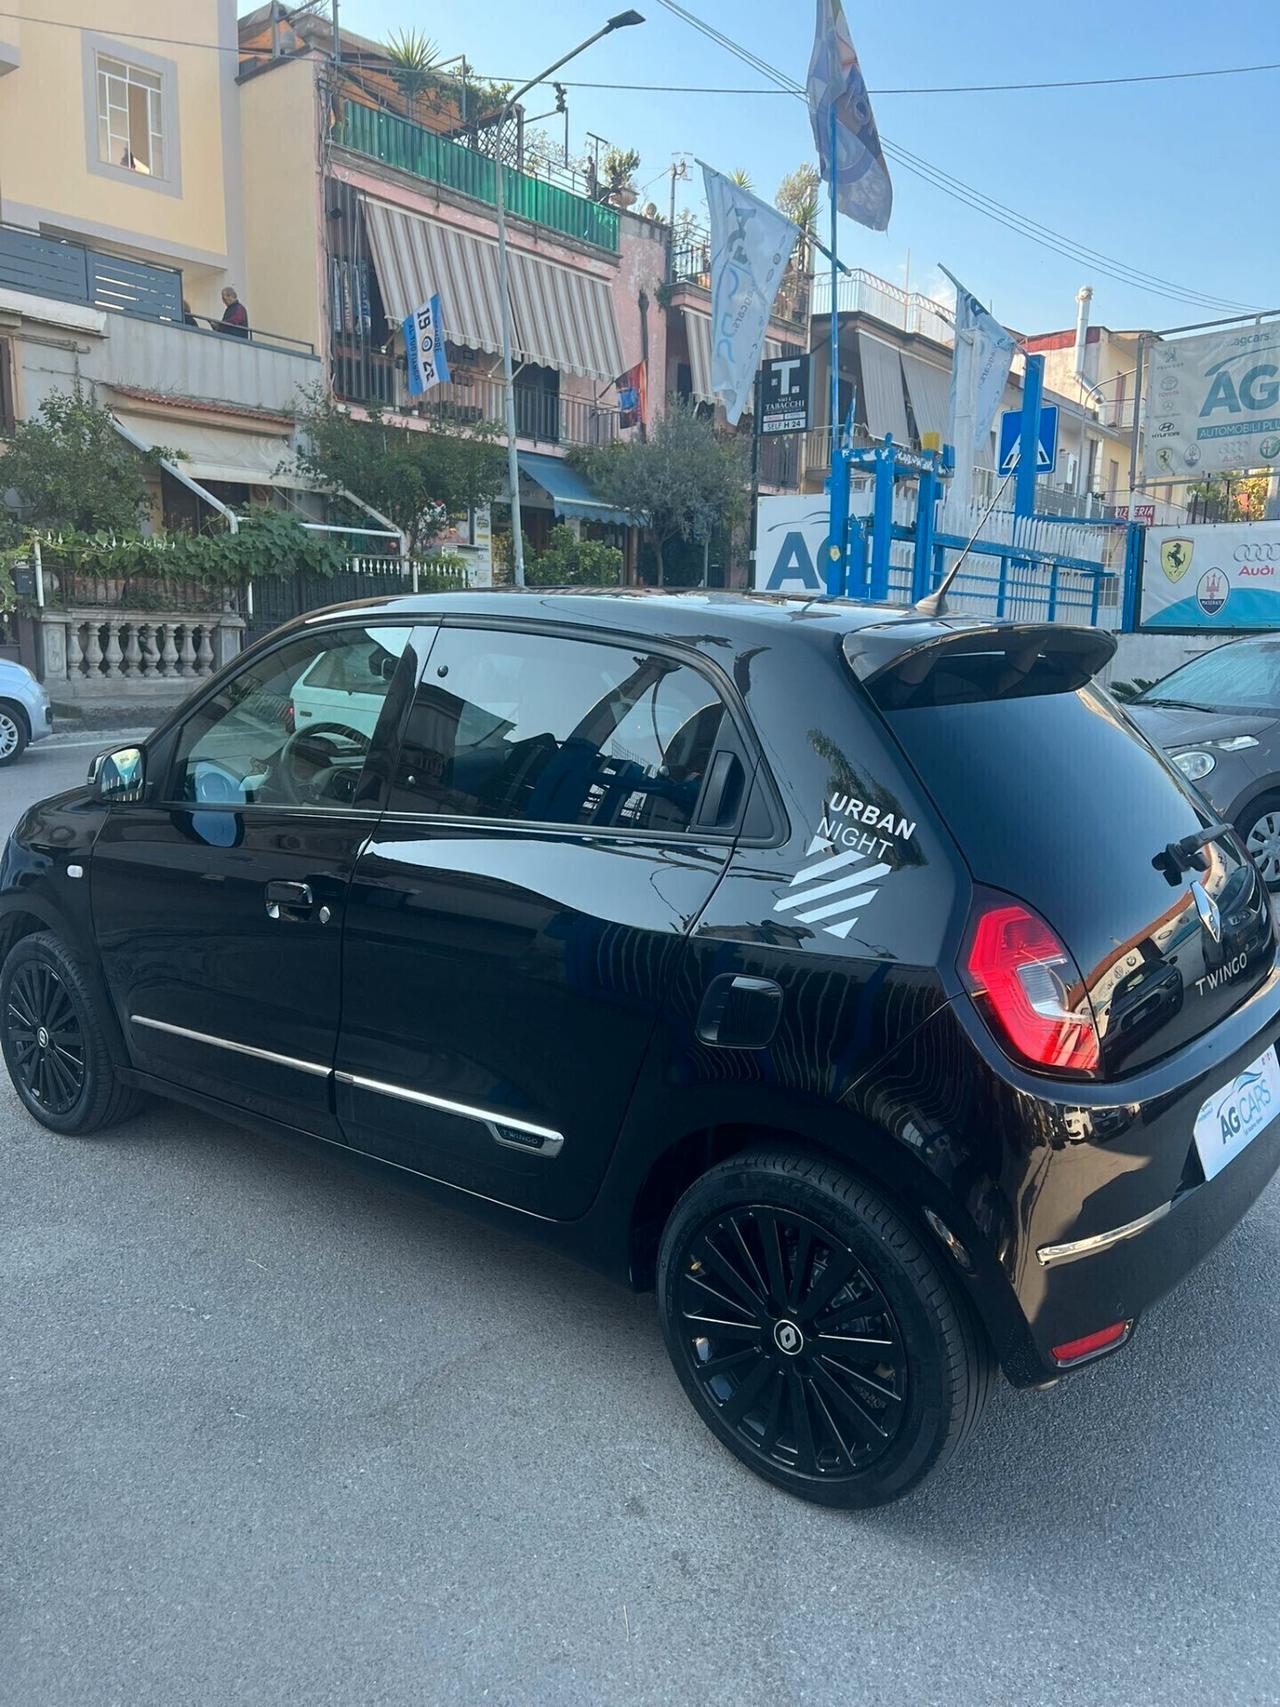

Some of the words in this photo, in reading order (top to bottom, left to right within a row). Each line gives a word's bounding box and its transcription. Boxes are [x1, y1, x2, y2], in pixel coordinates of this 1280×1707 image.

[766, 400, 804, 411] TABACCHI
[791, 420, 801, 428] 24
[1200, 422, 1260, 437] AUTOMOBILI
[1115, 506, 1154, 517] PIZERIA
[765, 532, 830, 590] A
[1238, 565, 1274, 576] Audi
[829, 792, 916, 840] URBAN
[817, 816, 893, 859] NIGHT
[1195, 952, 1248, 996] TWINGO
